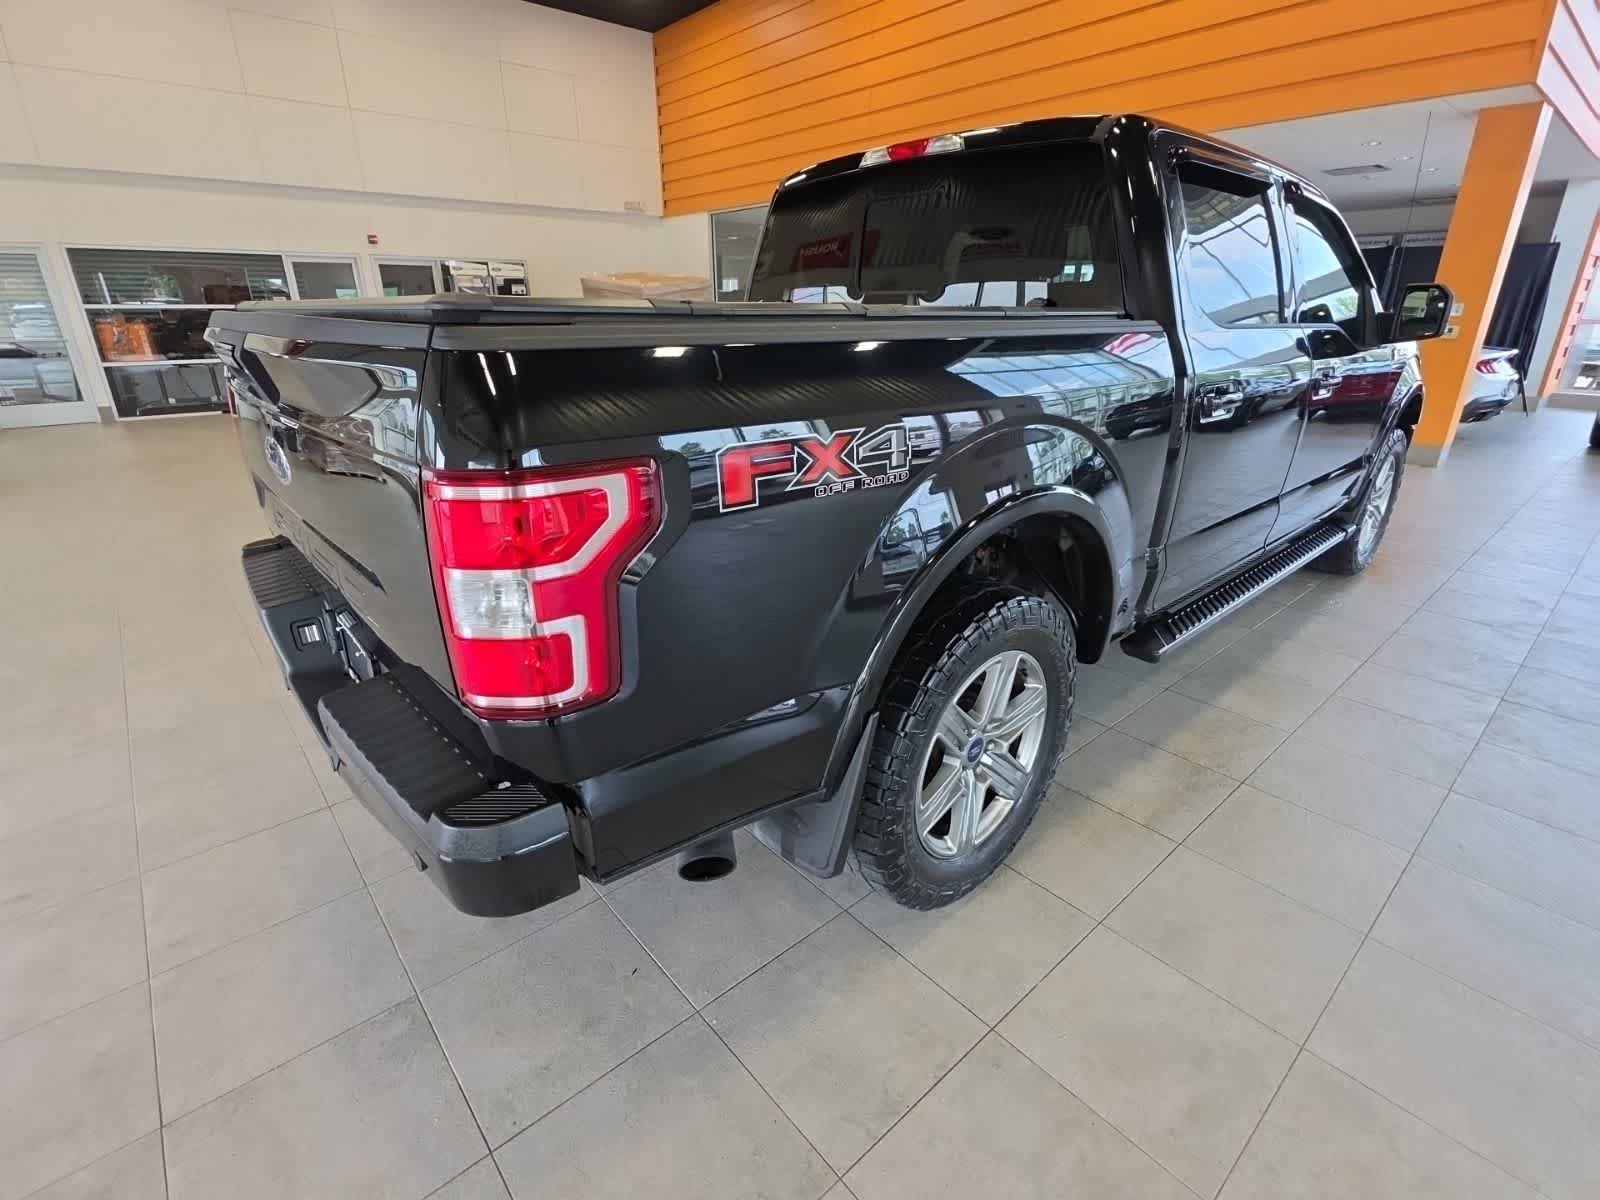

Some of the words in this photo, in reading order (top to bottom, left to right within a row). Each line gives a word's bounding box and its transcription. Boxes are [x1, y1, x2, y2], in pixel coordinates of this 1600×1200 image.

[716, 423, 911, 513] FX4
[815, 480, 855, 498] OFF
[861, 470, 910, 489] ROAD
